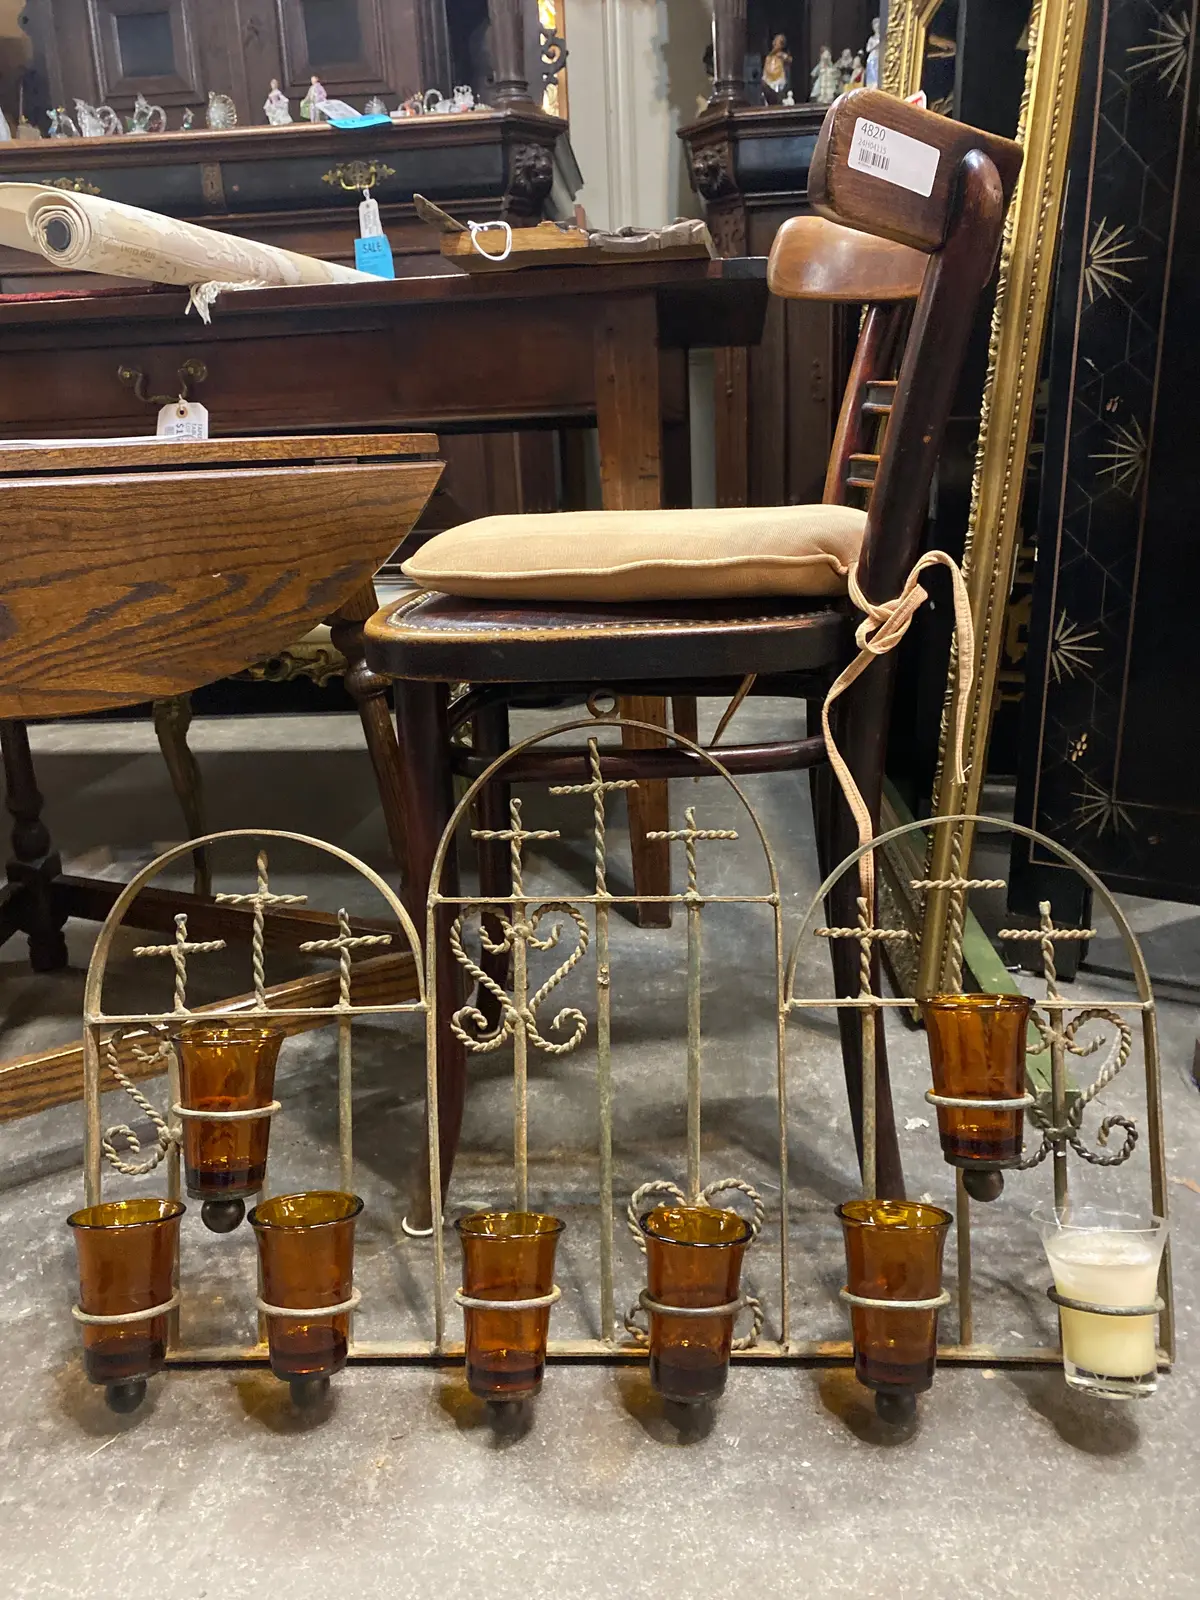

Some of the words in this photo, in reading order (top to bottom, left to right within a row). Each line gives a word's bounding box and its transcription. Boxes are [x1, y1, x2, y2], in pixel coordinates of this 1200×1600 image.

[861, 122, 886, 141] 4820
[362, 241, 382, 254] SALE
[175, 423, 185, 434] $1
